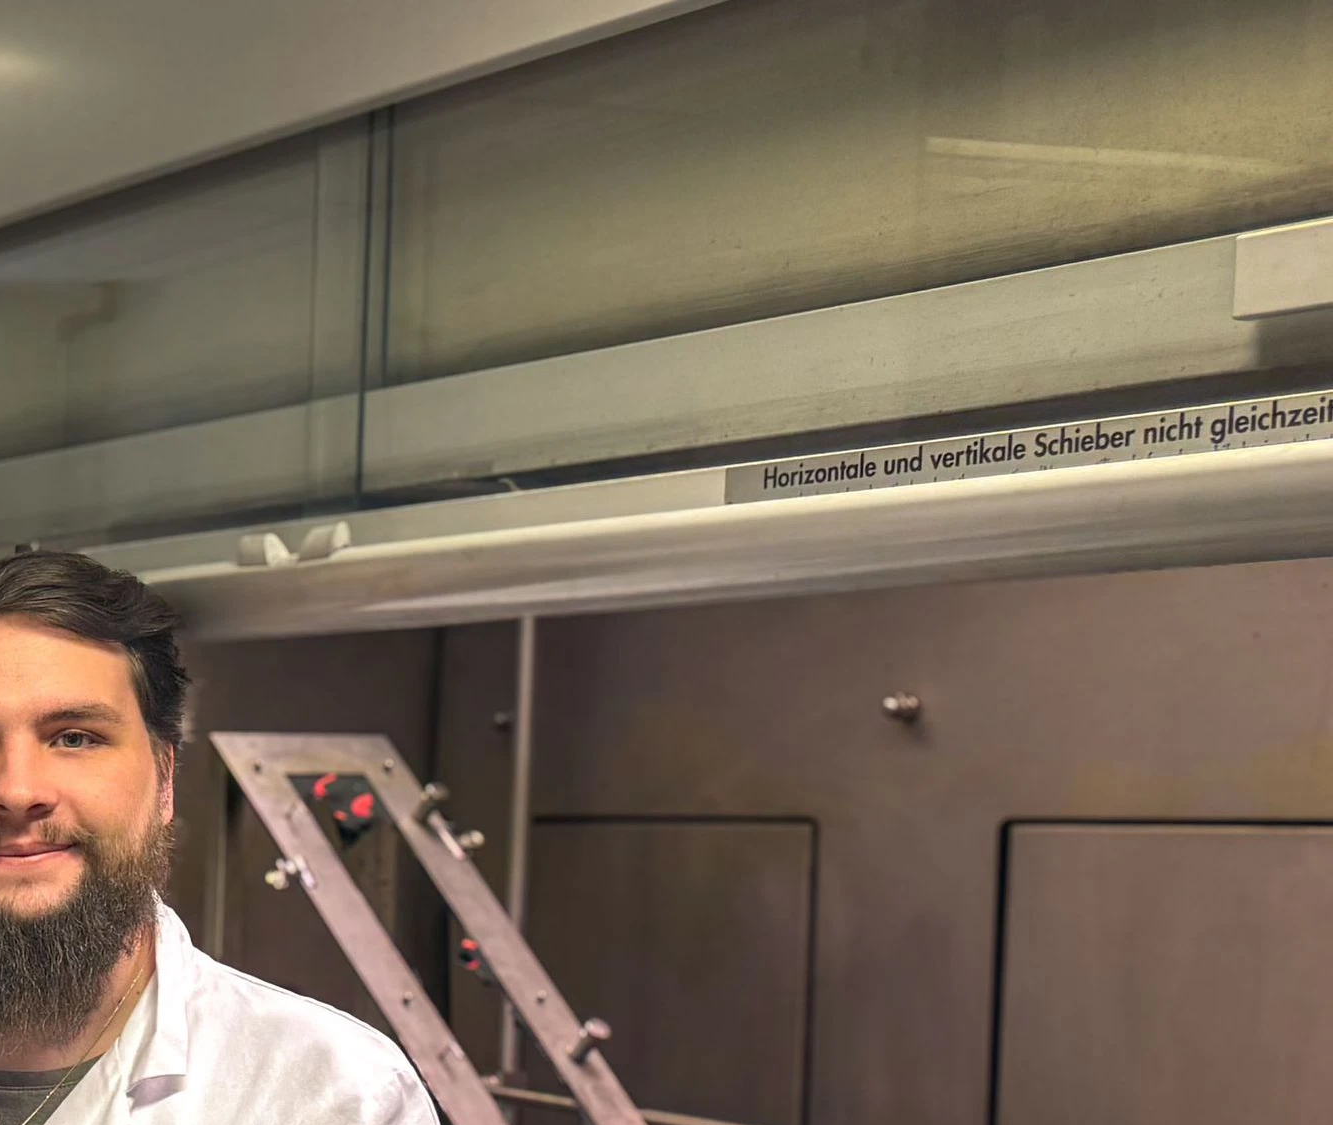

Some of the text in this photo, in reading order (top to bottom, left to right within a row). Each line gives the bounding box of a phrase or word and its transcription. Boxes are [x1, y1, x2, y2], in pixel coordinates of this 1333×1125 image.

[763, 453, 877, 490] Horizontale
[883, 445, 923, 476] und
[930, 434, 1027, 470] vertikale
[1033, 422, 1136, 458] Schieber
[1143, 411, 1204, 446] nicht
